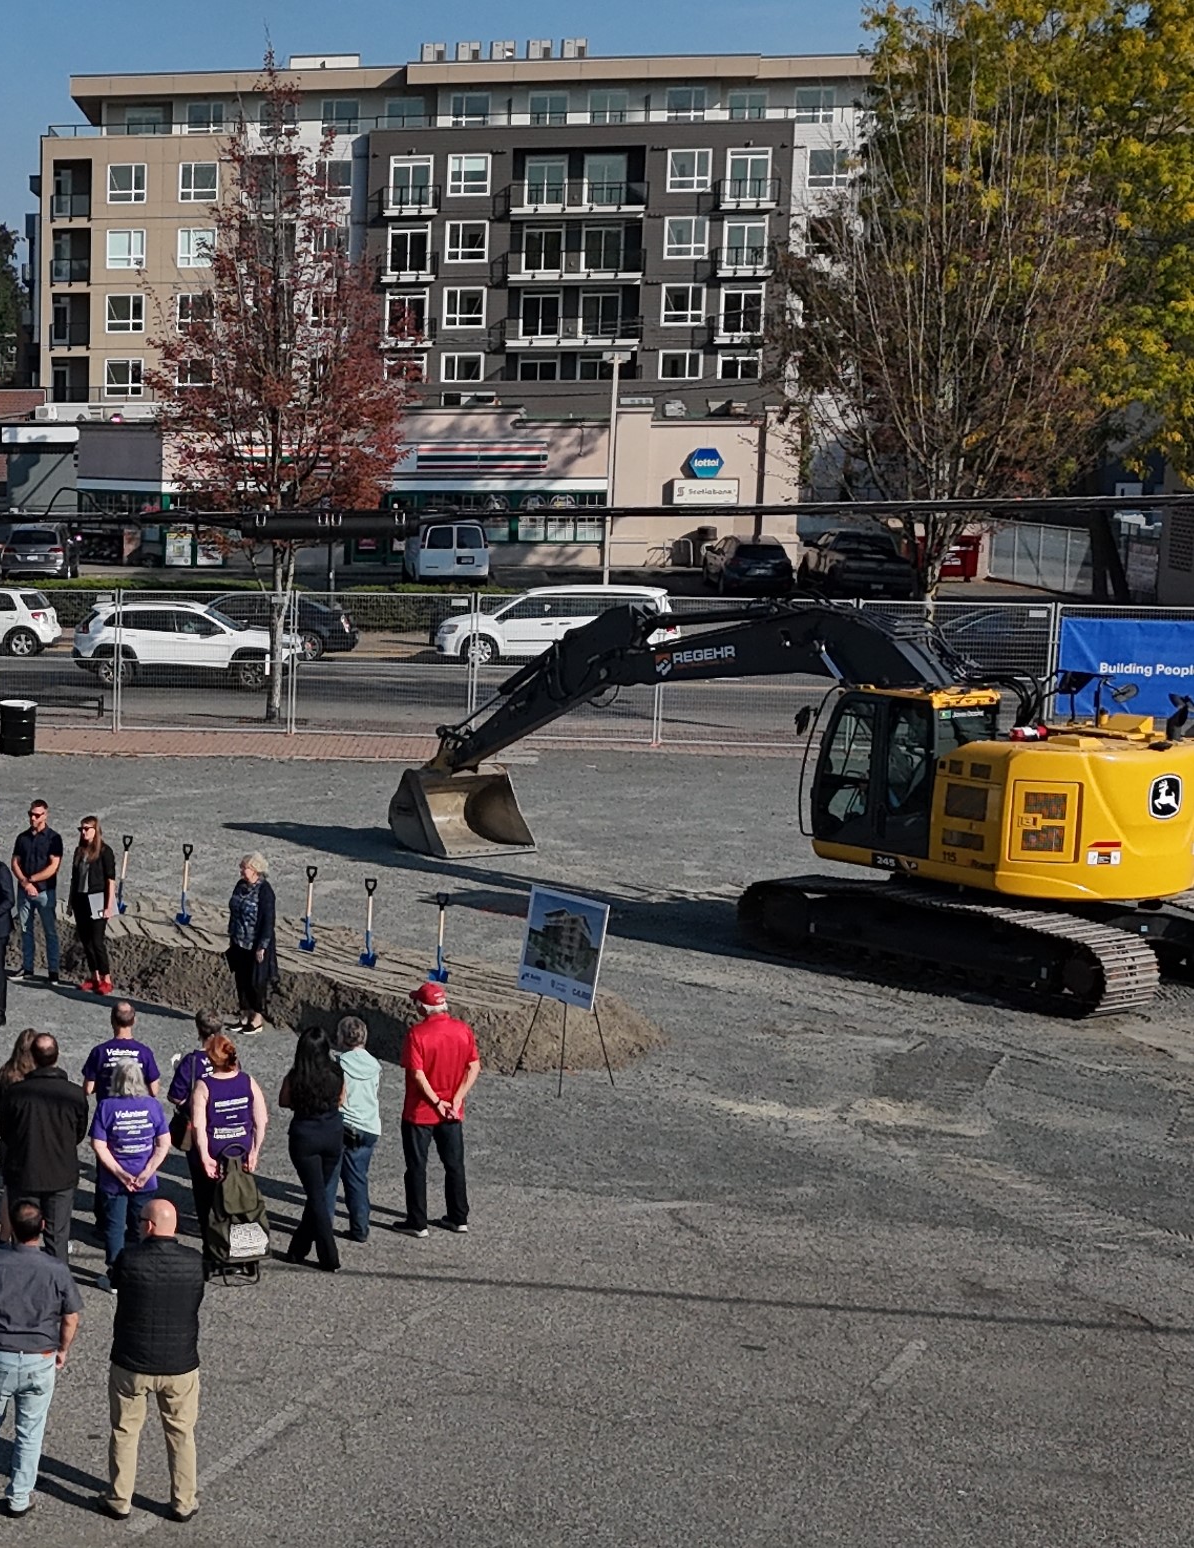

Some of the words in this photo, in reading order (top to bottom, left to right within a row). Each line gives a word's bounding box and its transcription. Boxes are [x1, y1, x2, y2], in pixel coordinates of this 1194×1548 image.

[672, 645, 736, 664] REGEHR
[1099, 662, 1153, 677] Building
[1156, 664, 1194, 678] Peopl
[876, 856, 896, 867] 245
[942, 851, 957, 862] 115
[106, 1049, 139, 1057] Volunteer
[115, 1110, 149, 1119] Volunteer
